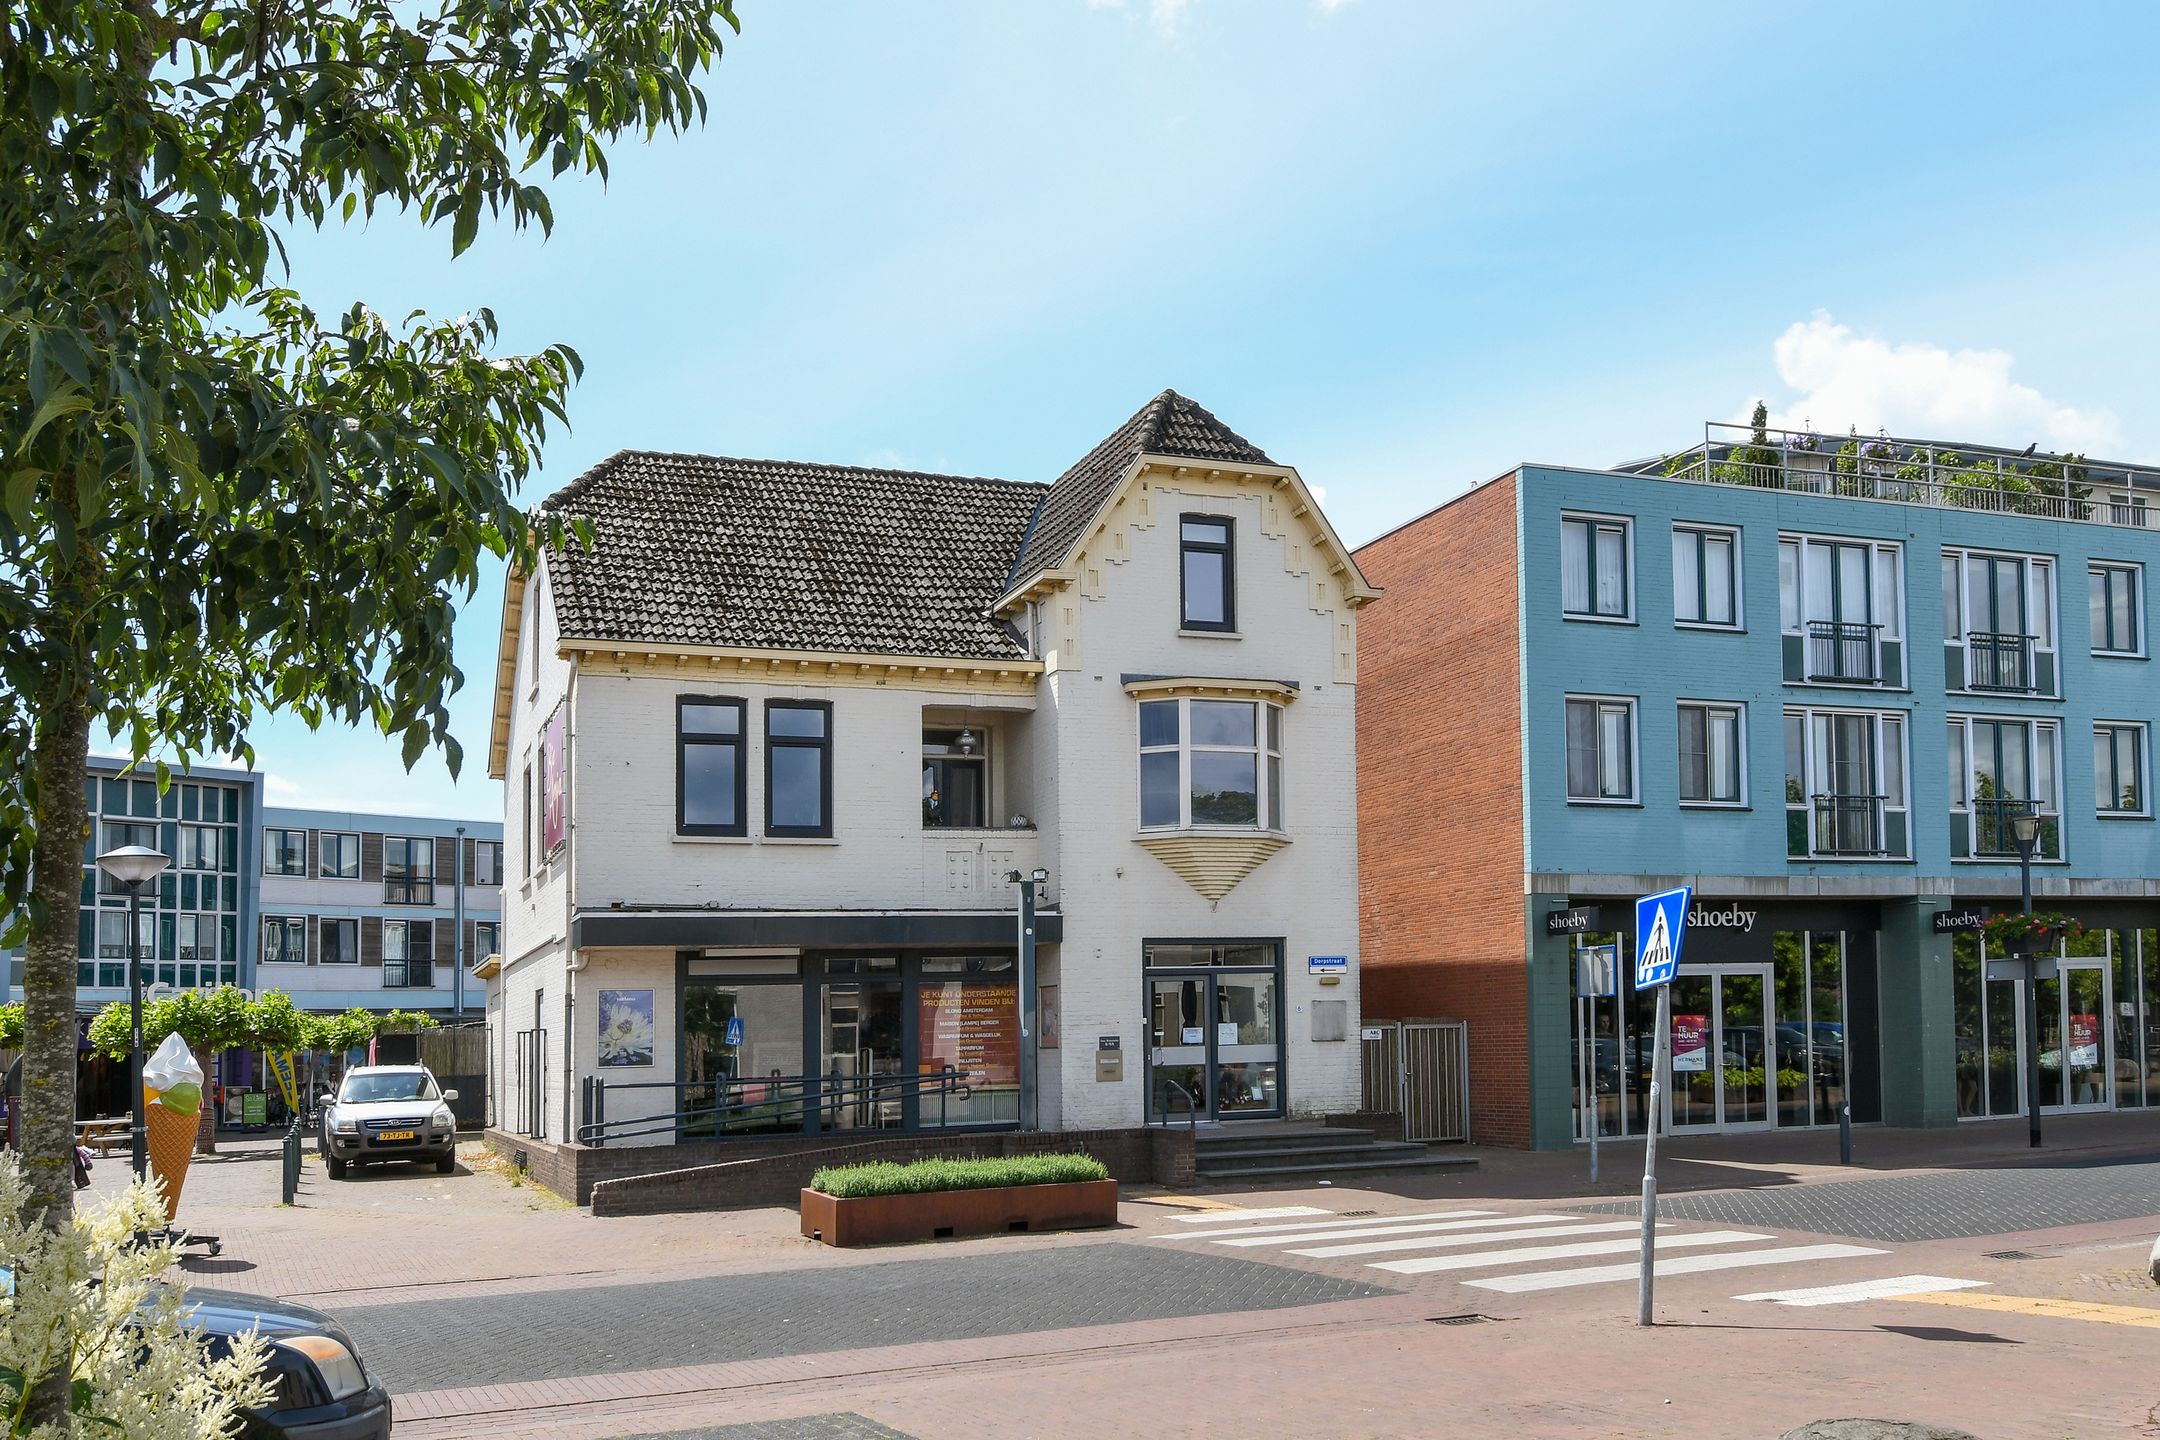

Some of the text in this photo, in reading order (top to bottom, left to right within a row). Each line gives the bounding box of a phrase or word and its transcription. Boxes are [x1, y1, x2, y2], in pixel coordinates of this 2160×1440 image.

[1550, 911, 1588, 930] shoeby
[1687, 902, 1757, 932] shoeby
[1936, 911, 1980, 928] shoeby
[921, 991, 931, 999] JE
[955, 989, 1016, 998] ONDERSTAANDE
[923, 999, 969, 1007] PRODUCTEN
[971, 998, 1000, 1006] VINDEN
